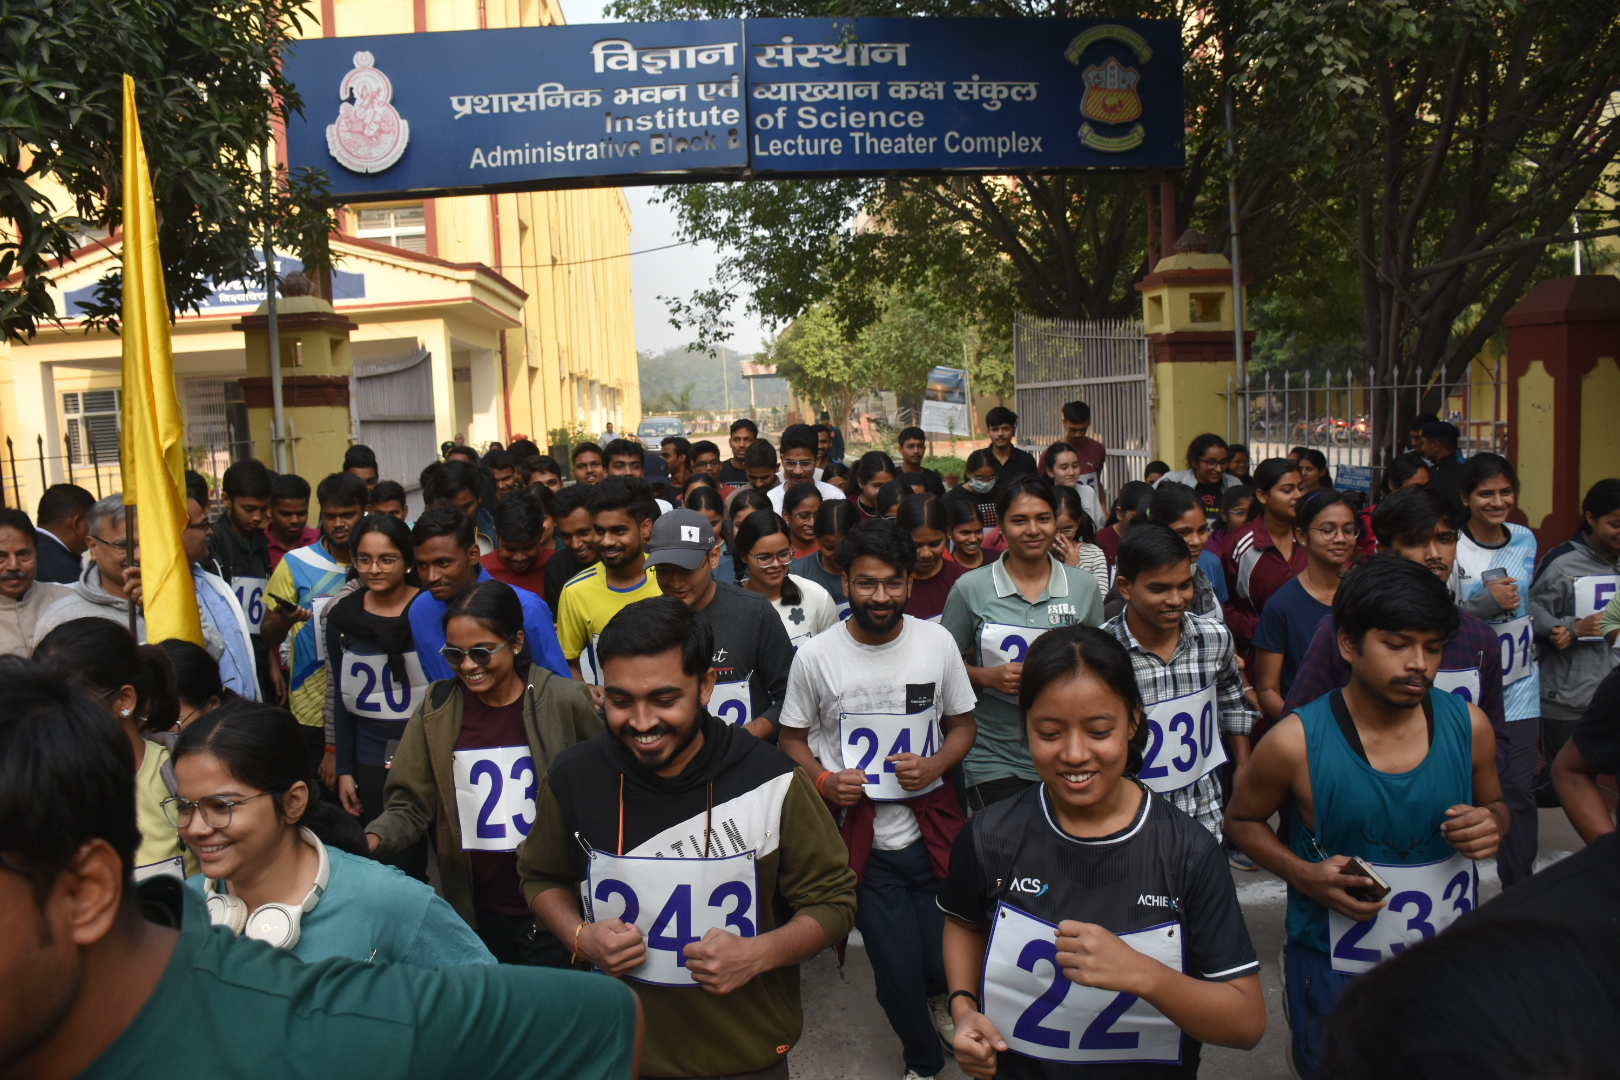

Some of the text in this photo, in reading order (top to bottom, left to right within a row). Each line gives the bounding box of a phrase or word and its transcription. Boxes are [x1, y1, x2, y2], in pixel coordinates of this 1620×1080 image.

[590, 35, 910, 74] विज्ञान संस्थान
[449, 73, 1039, 120] प्रशासनिक भवन एवं व्याख्यान कक्ष संकुल
[606, 105, 925, 133] Institute of Science
[469, 128, 1043, 168] Administrative Block & Lecture Theater Complex
[351, 662, 411, 713] 20
[1138, 700, 1213, 779] 230
[470, 756, 540, 838] 23
[595, 879, 755, 967] 243
[1333, 870, 1472, 962] 233
